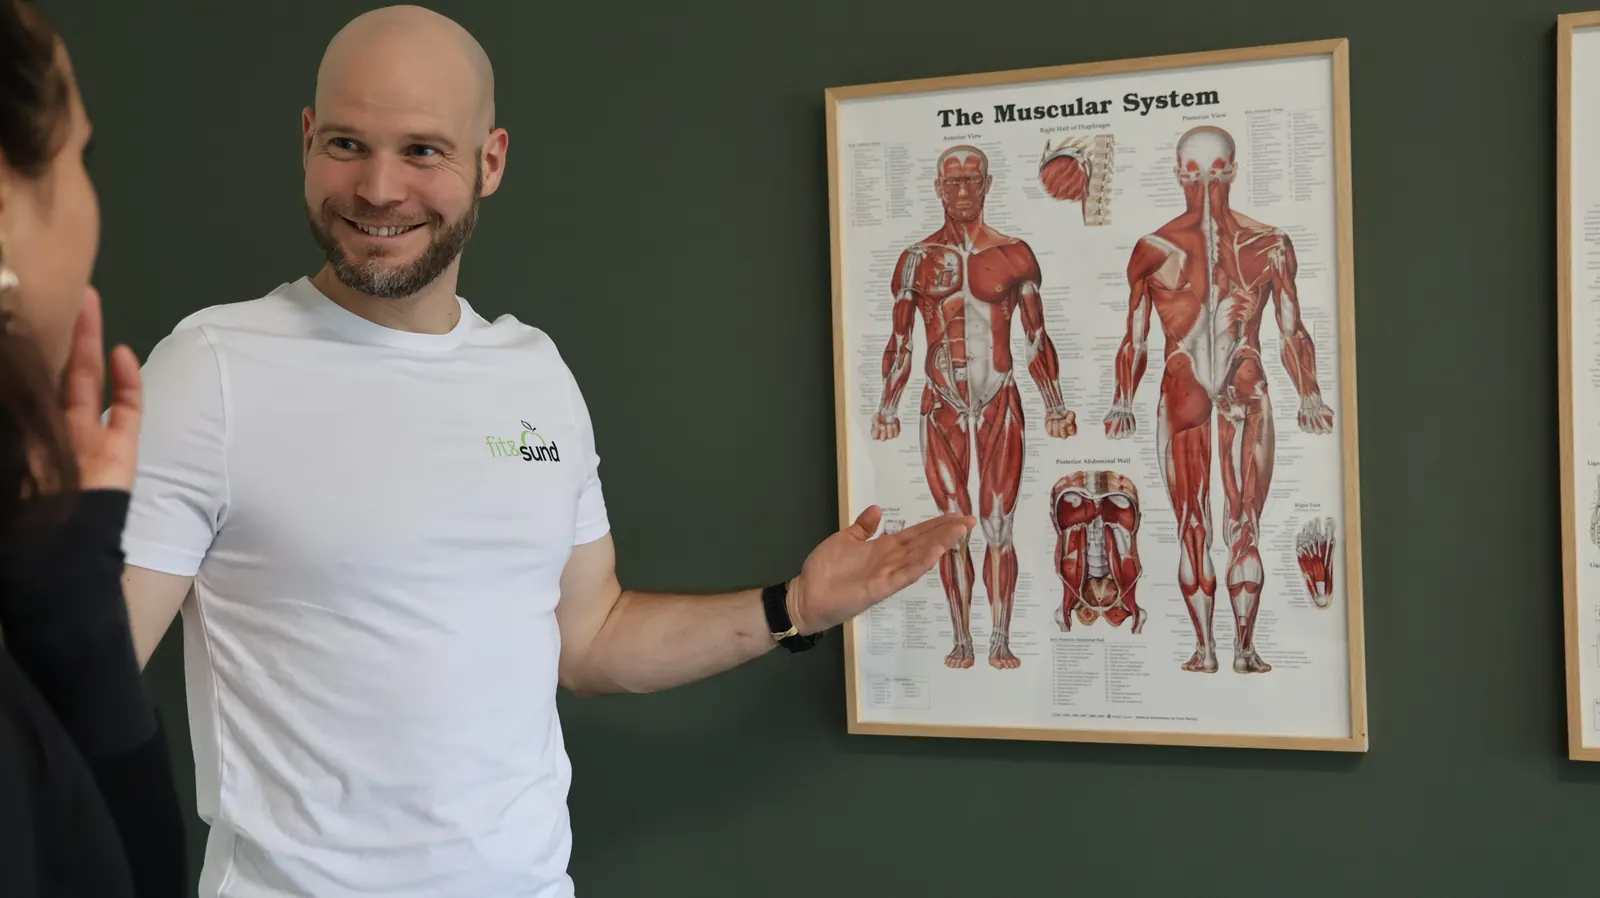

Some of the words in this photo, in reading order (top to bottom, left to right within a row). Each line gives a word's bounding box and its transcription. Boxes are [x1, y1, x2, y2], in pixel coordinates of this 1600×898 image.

[937, 107, 984, 128] The
[993, 97, 1112, 123] Muscular
[1123, 89, 1220, 116] System
[1039, 126, 1055, 134] Right
[1078, 122, 1111, 131] Diaphragm
